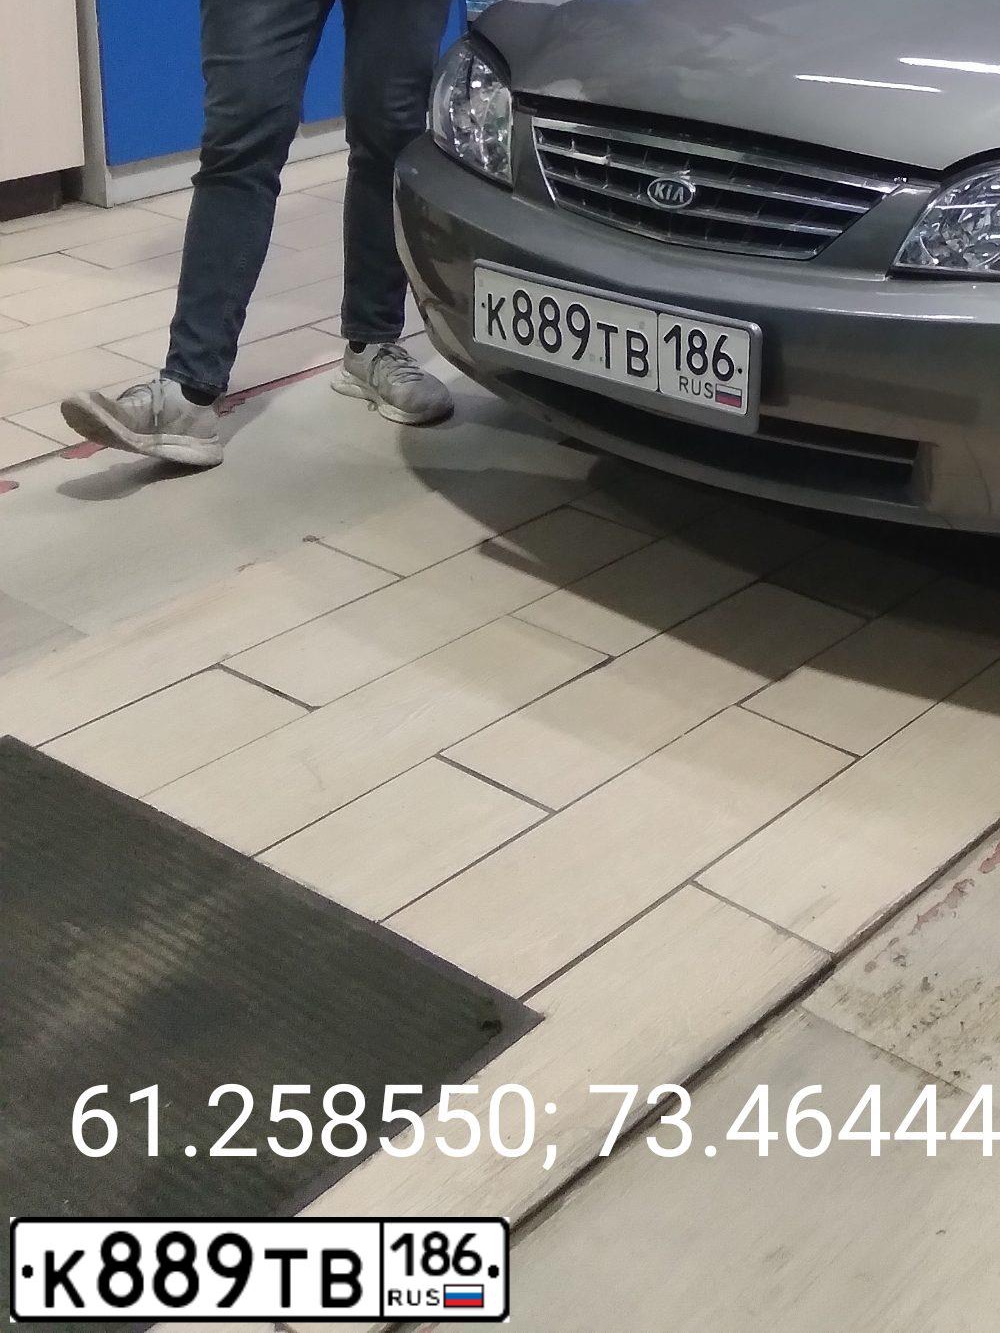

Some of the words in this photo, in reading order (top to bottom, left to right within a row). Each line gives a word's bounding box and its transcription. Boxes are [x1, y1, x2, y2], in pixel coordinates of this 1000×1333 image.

[654, 182, 684, 203] KIA
[487, 289, 649, 378] К889ТВ
[663, 323, 735, 382] 186
[678, 375, 714, 400] RUS
